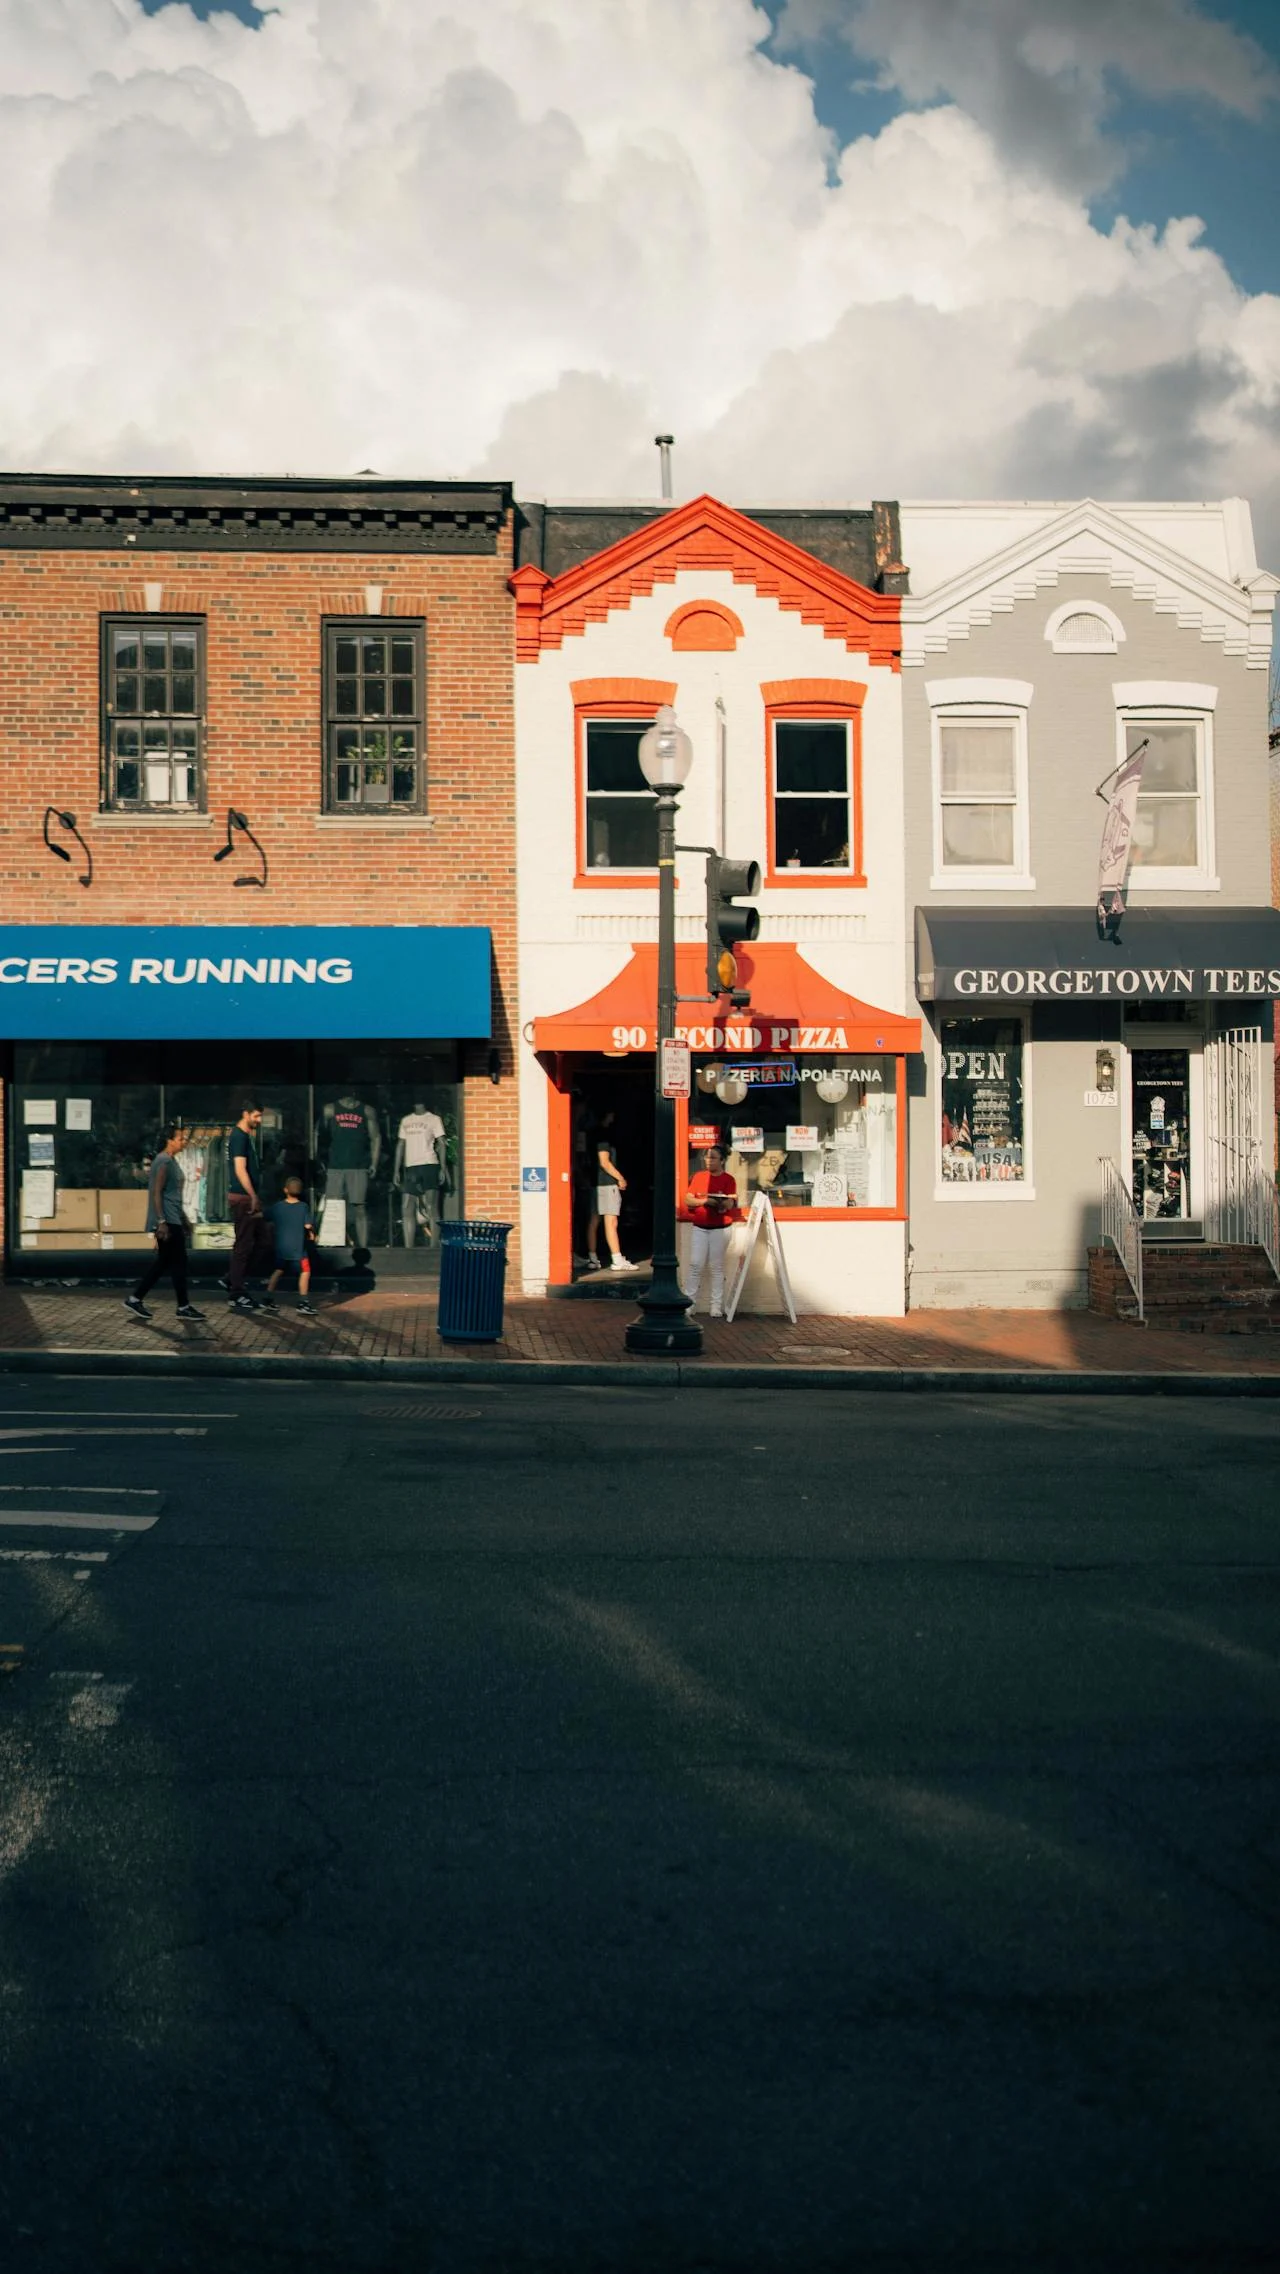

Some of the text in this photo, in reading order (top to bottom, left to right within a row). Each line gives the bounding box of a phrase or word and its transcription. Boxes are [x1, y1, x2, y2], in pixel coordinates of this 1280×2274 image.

[129, 958, 353, 984] RUNNING
[953, 969, 1280, 995] GEORGETOWN TEES
[612, 1026, 849, 1049] 90 ECOND PIZZA
[705, 1069, 776, 1082] PIZZERIA
[780, 1068, 882, 1082] NAPOLETANA
[1087, 1093, 1116, 1105] 1075
[982, 1152, 1012, 1165] USA
